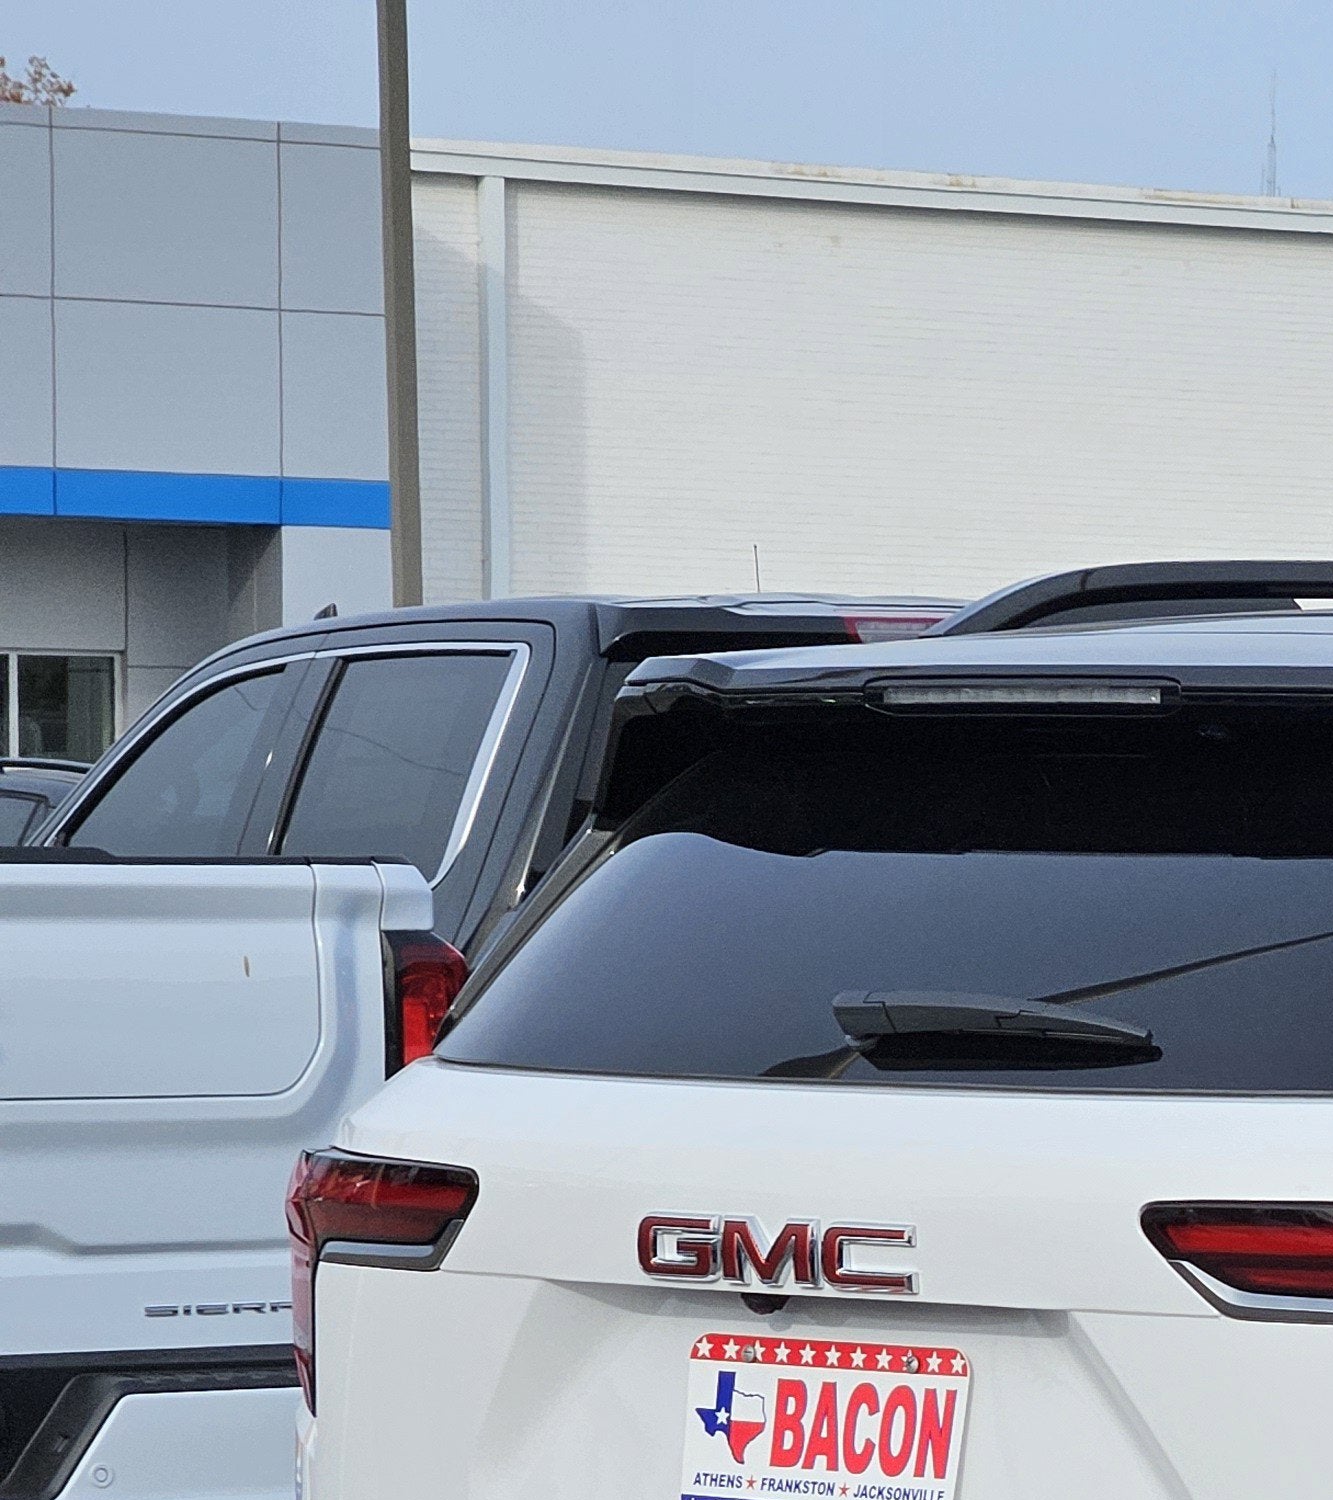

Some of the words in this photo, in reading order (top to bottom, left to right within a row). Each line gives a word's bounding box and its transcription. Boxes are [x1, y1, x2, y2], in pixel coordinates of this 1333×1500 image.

[638, 1210, 920, 1295] GMC
[144, 1300, 293, 1318] SIERR
[769, 1377, 958, 1480] BACON
[693, 1472, 743, 1489] ATHENS
[760, 1477, 836, 1497] FRANKSTON
